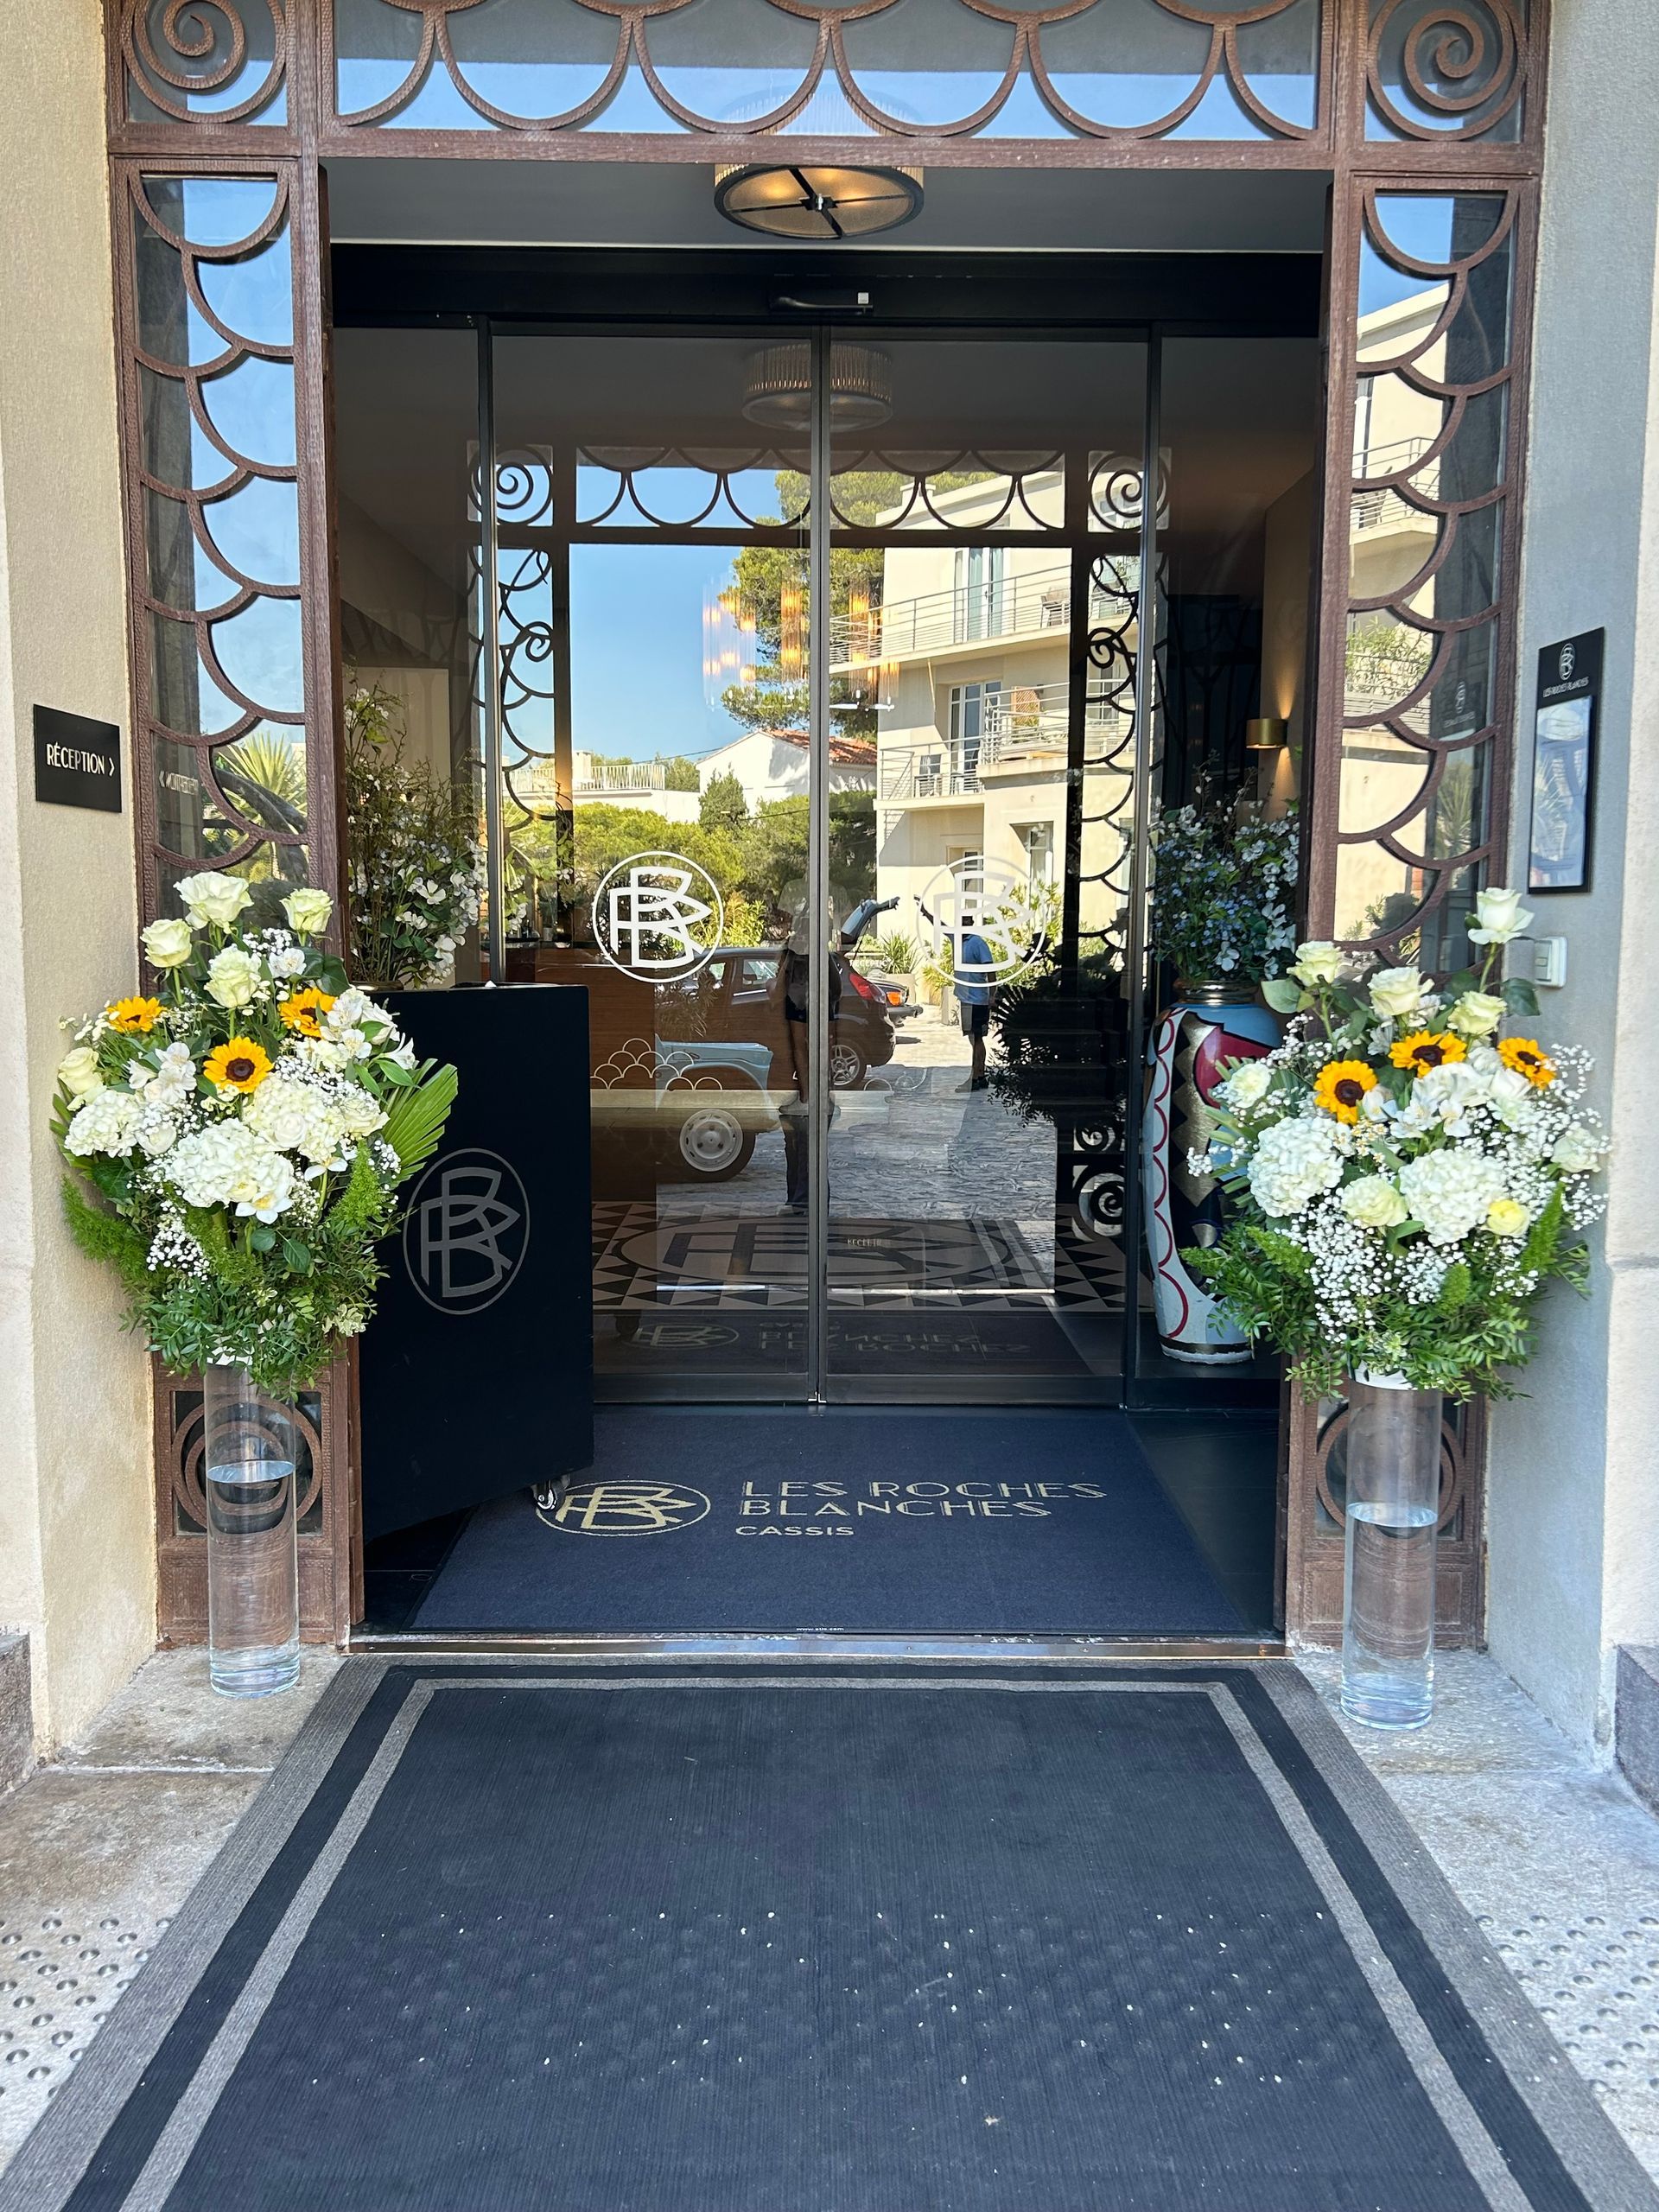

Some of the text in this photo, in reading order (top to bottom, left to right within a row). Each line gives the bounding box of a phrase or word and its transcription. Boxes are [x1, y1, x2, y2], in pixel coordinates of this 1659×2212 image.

[46, 741, 105, 774] RÉCEPTION
[742, 1481, 1108, 1498] LES ROCHES
[740, 1500, 1052, 1516] BLANCHES
[735, 1526, 854, 1536] CASSIS
